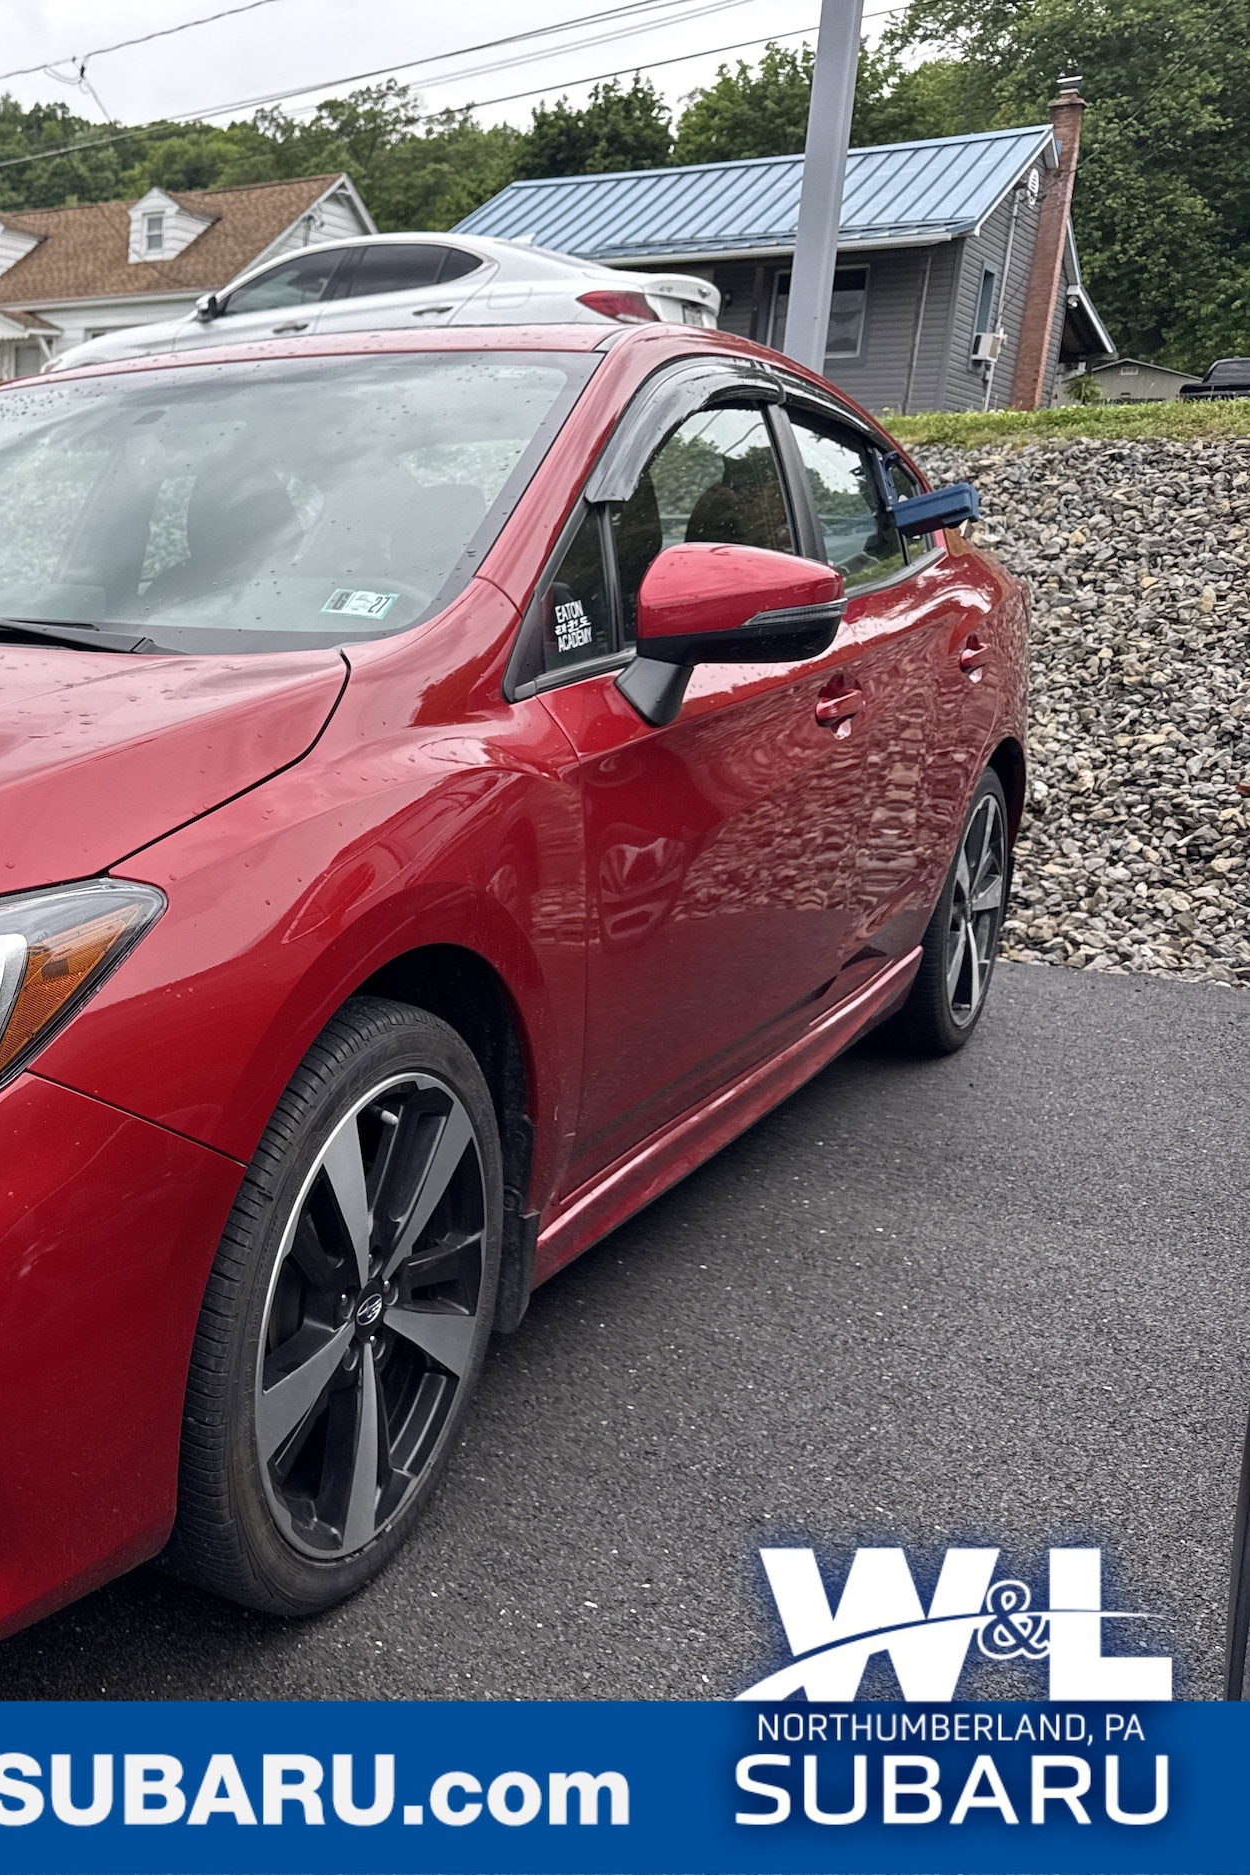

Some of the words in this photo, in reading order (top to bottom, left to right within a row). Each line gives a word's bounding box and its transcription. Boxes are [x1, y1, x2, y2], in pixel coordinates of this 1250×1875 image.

[368, 596, 392, 614] 27
[554, 600, 584, 624] EATON
[558, 627, 593, 653] ACADEMY
